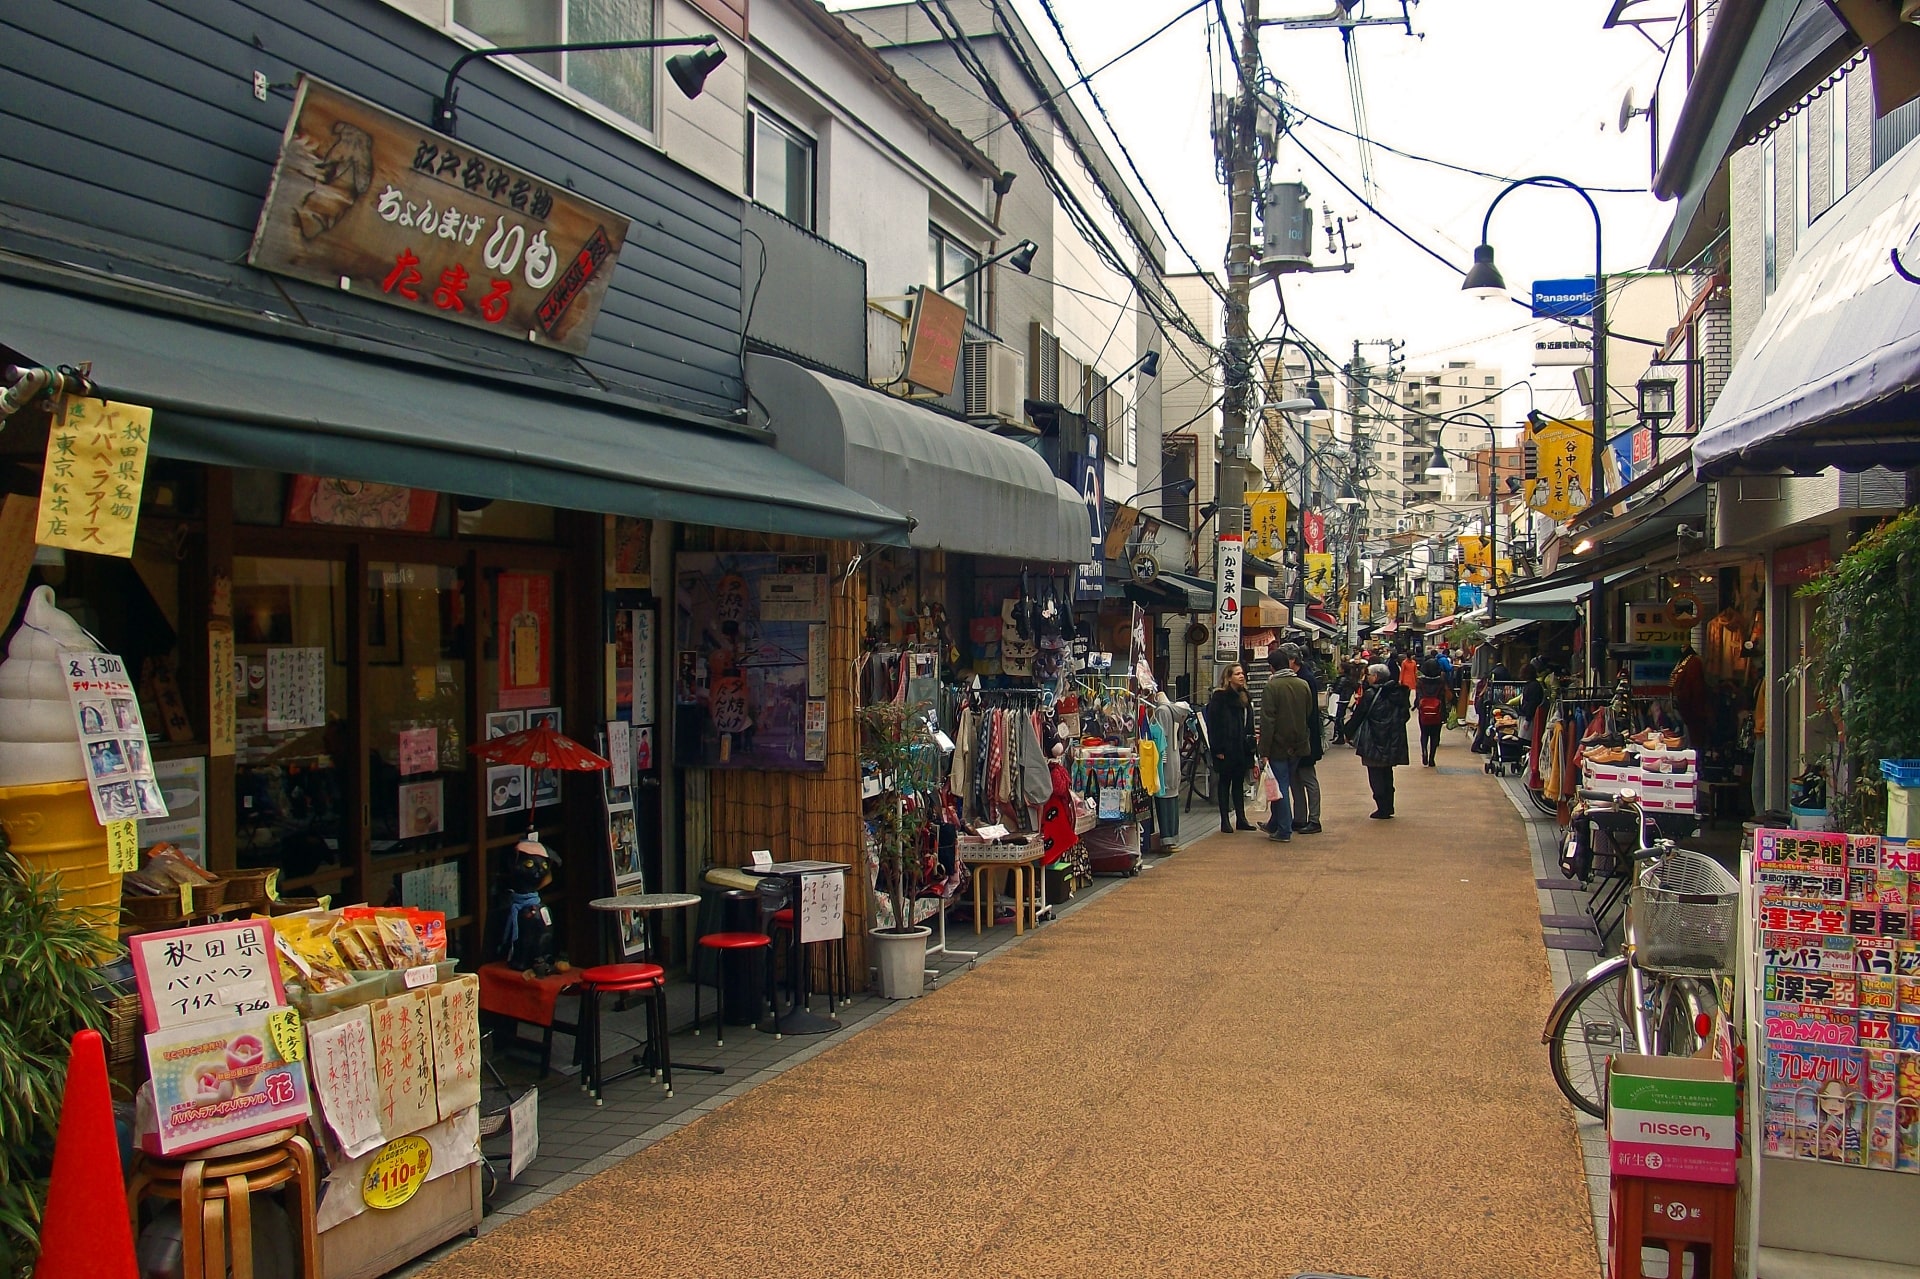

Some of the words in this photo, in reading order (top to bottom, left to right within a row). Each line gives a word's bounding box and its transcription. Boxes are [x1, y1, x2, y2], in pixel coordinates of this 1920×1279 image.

[377, 183, 558, 289] ちょんまげいも
[383, 247, 513, 324] たまる
[1535, 293, 1594, 303] Panasonic
[110, 421, 148, 520] 秋田県名物
[1565, 440, 1577, 474] 谷中へ
[81, 411, 120, 545] ババヘラアイス
[1553, 456, 1563, 502] ようこそ
[1260, 516, 1268, 547] ようこそ
[1268, 505, 1278, 528] 谷中へ
[1223, 555, 1237, 594] かき氷
[69, 660, 86, 677] 各
[89, 656, 121, 678] ¥300
[1775, 837, 1842, 865] 漢字館
[1760, 906, 1845, 935] 漢字堂
[163, 928, 264, 967] 秋田県
[1772, 934, 1802, 950] 漢字
[1765, 949, 1821, 968] ナンパラ
[168, 965, 253, 991] ババヘラ
[1776, 975, 1834, 1003] 漢字
[171, 993, 217, 1016] アイス
[235, 1000, 270, 1017] ¥260
[284, 1011, 301, 1061] 食べ歩き
[398, 1006, 415, 1094] 東京地区
[452, 991, 465, 1081] 特約代理店
[379, 1010, 398, 1127] 特約店です
[265, 1072, 296, 1107] 花
[1618, 1151, 1663, 1170] 新生活
